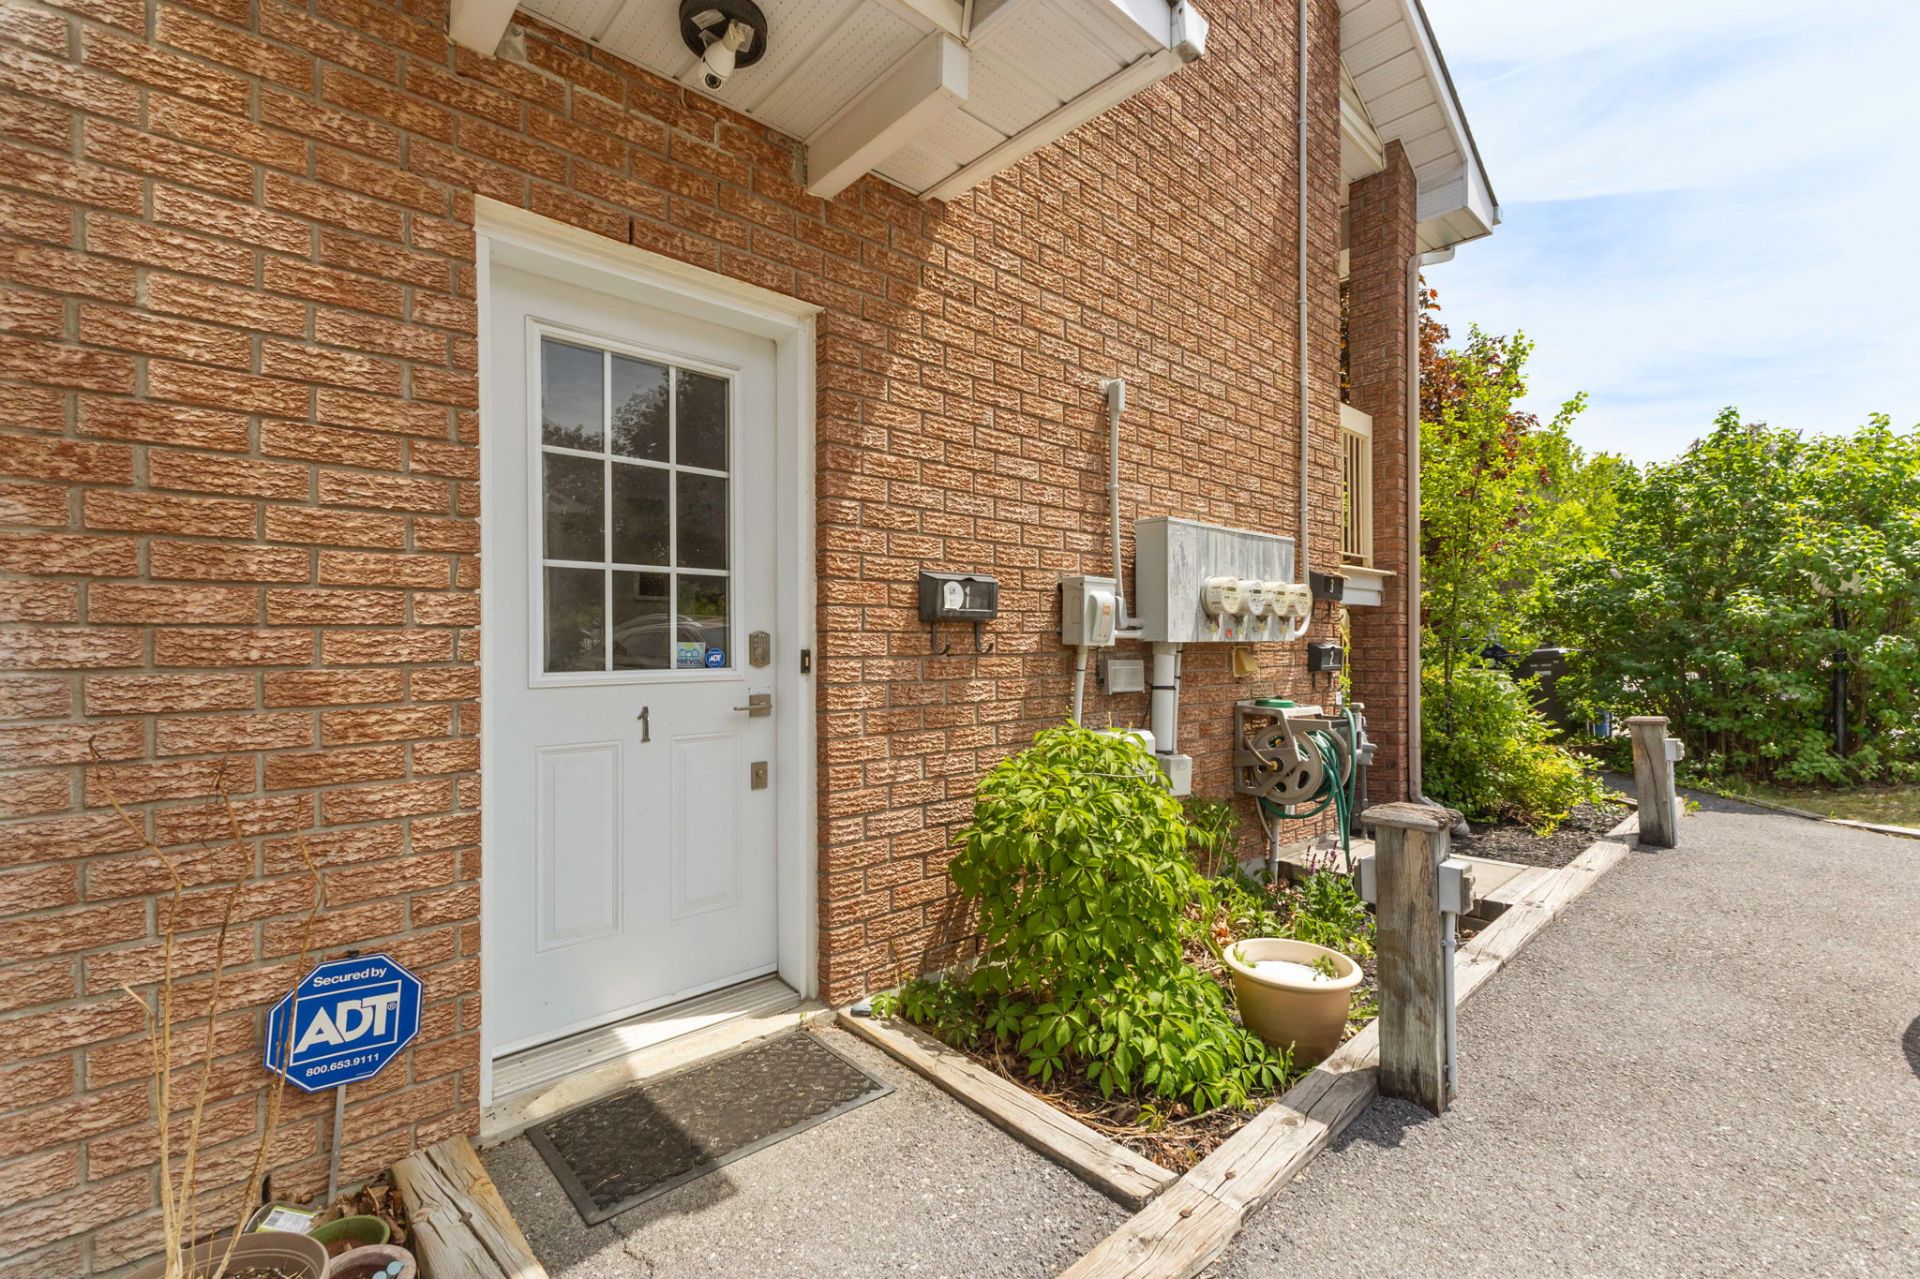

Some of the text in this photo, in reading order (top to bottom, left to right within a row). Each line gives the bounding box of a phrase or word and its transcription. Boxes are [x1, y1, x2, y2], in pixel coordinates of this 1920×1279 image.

[636, 705, 651, 744] 1
[313, 967, 387, 988] Secured by
[294, 992, 400, 1054] ADT
[306, 1053, 379, 1077] 800.653.9111
